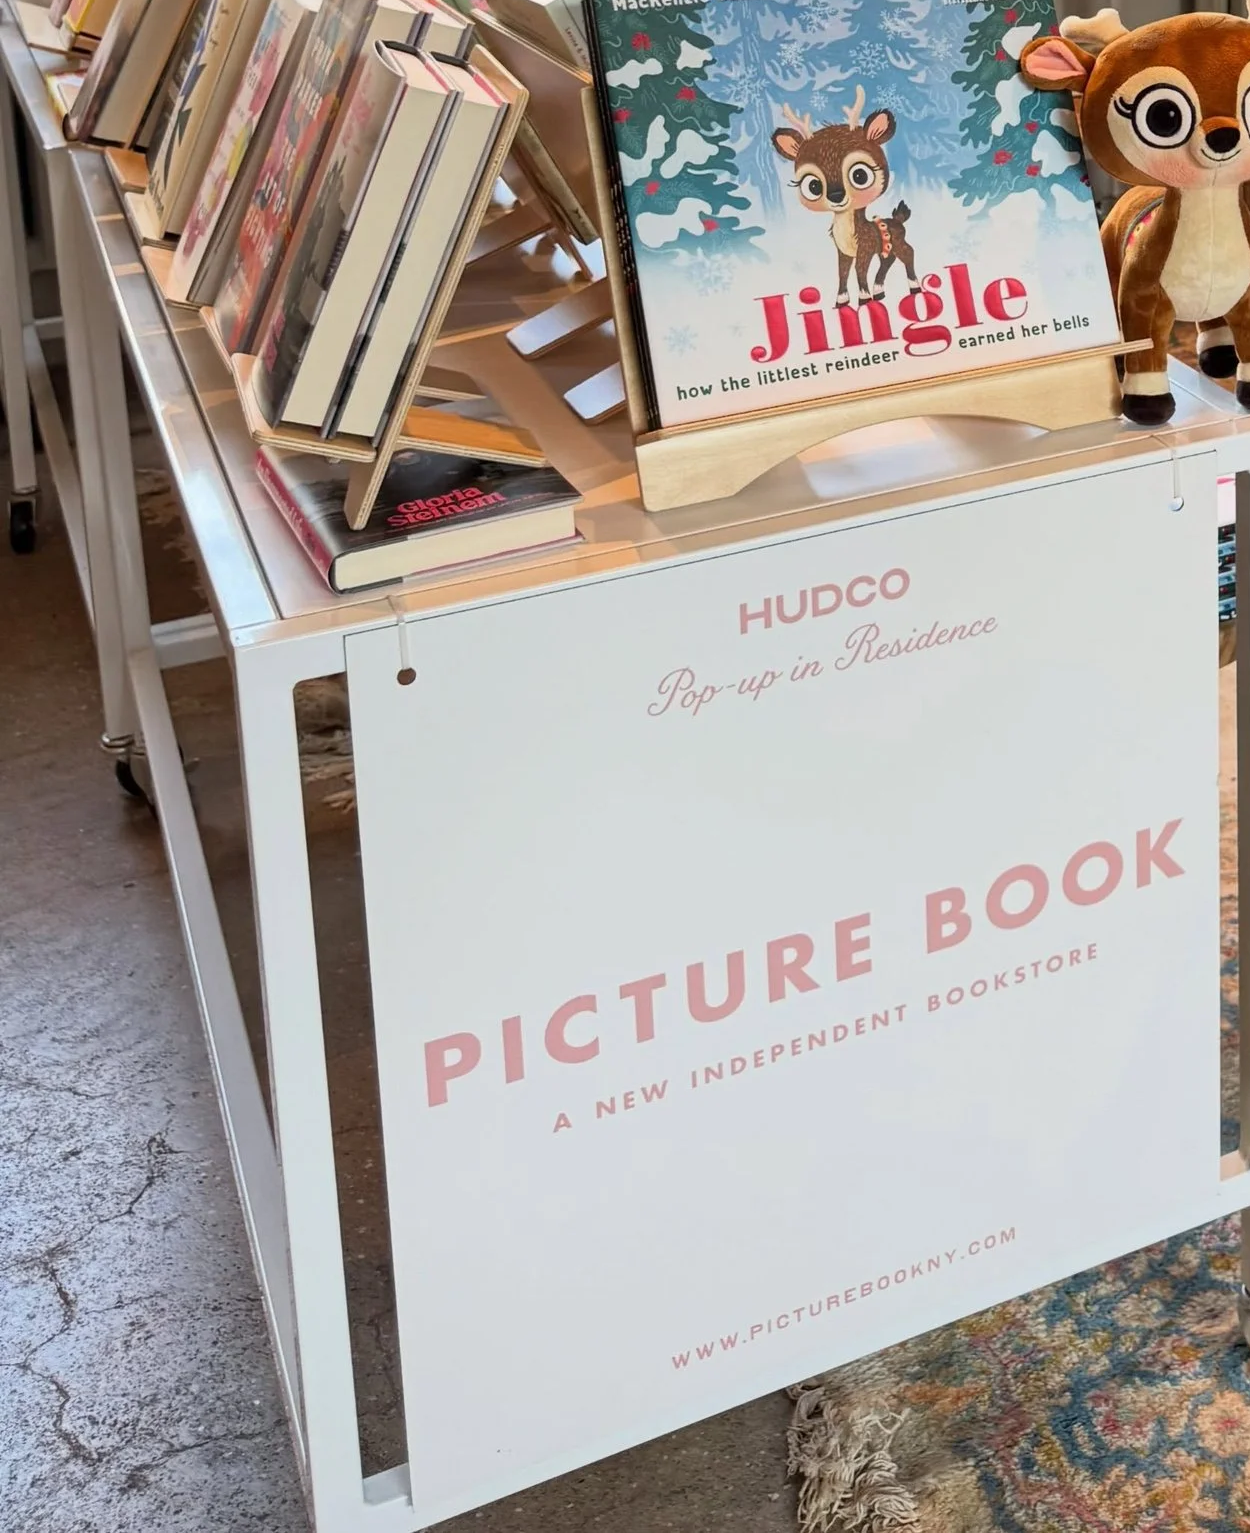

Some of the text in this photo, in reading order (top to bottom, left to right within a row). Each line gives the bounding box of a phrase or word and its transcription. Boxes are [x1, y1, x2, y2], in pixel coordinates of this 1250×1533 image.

[677, 313, 1091, 401] how the littlest reindeer earned her bells
[750, 262, 1029, 364] Jingle
[387, 492, 507, 528] Steinem
[396, 485, 485, 515] Gloria
[738, 567, 911, 635] HUDCO
[646, 613, 999, 717] Pop-up in Residence
[423, 818, 1187, 1109] PICTURE BOOK
[552, 942, 1100, 1133] A NEW INDEPENDENT BOOKSTORE
[671, 1226, 1018, 1370] WWW.PICTUREBOOKNY.COM
